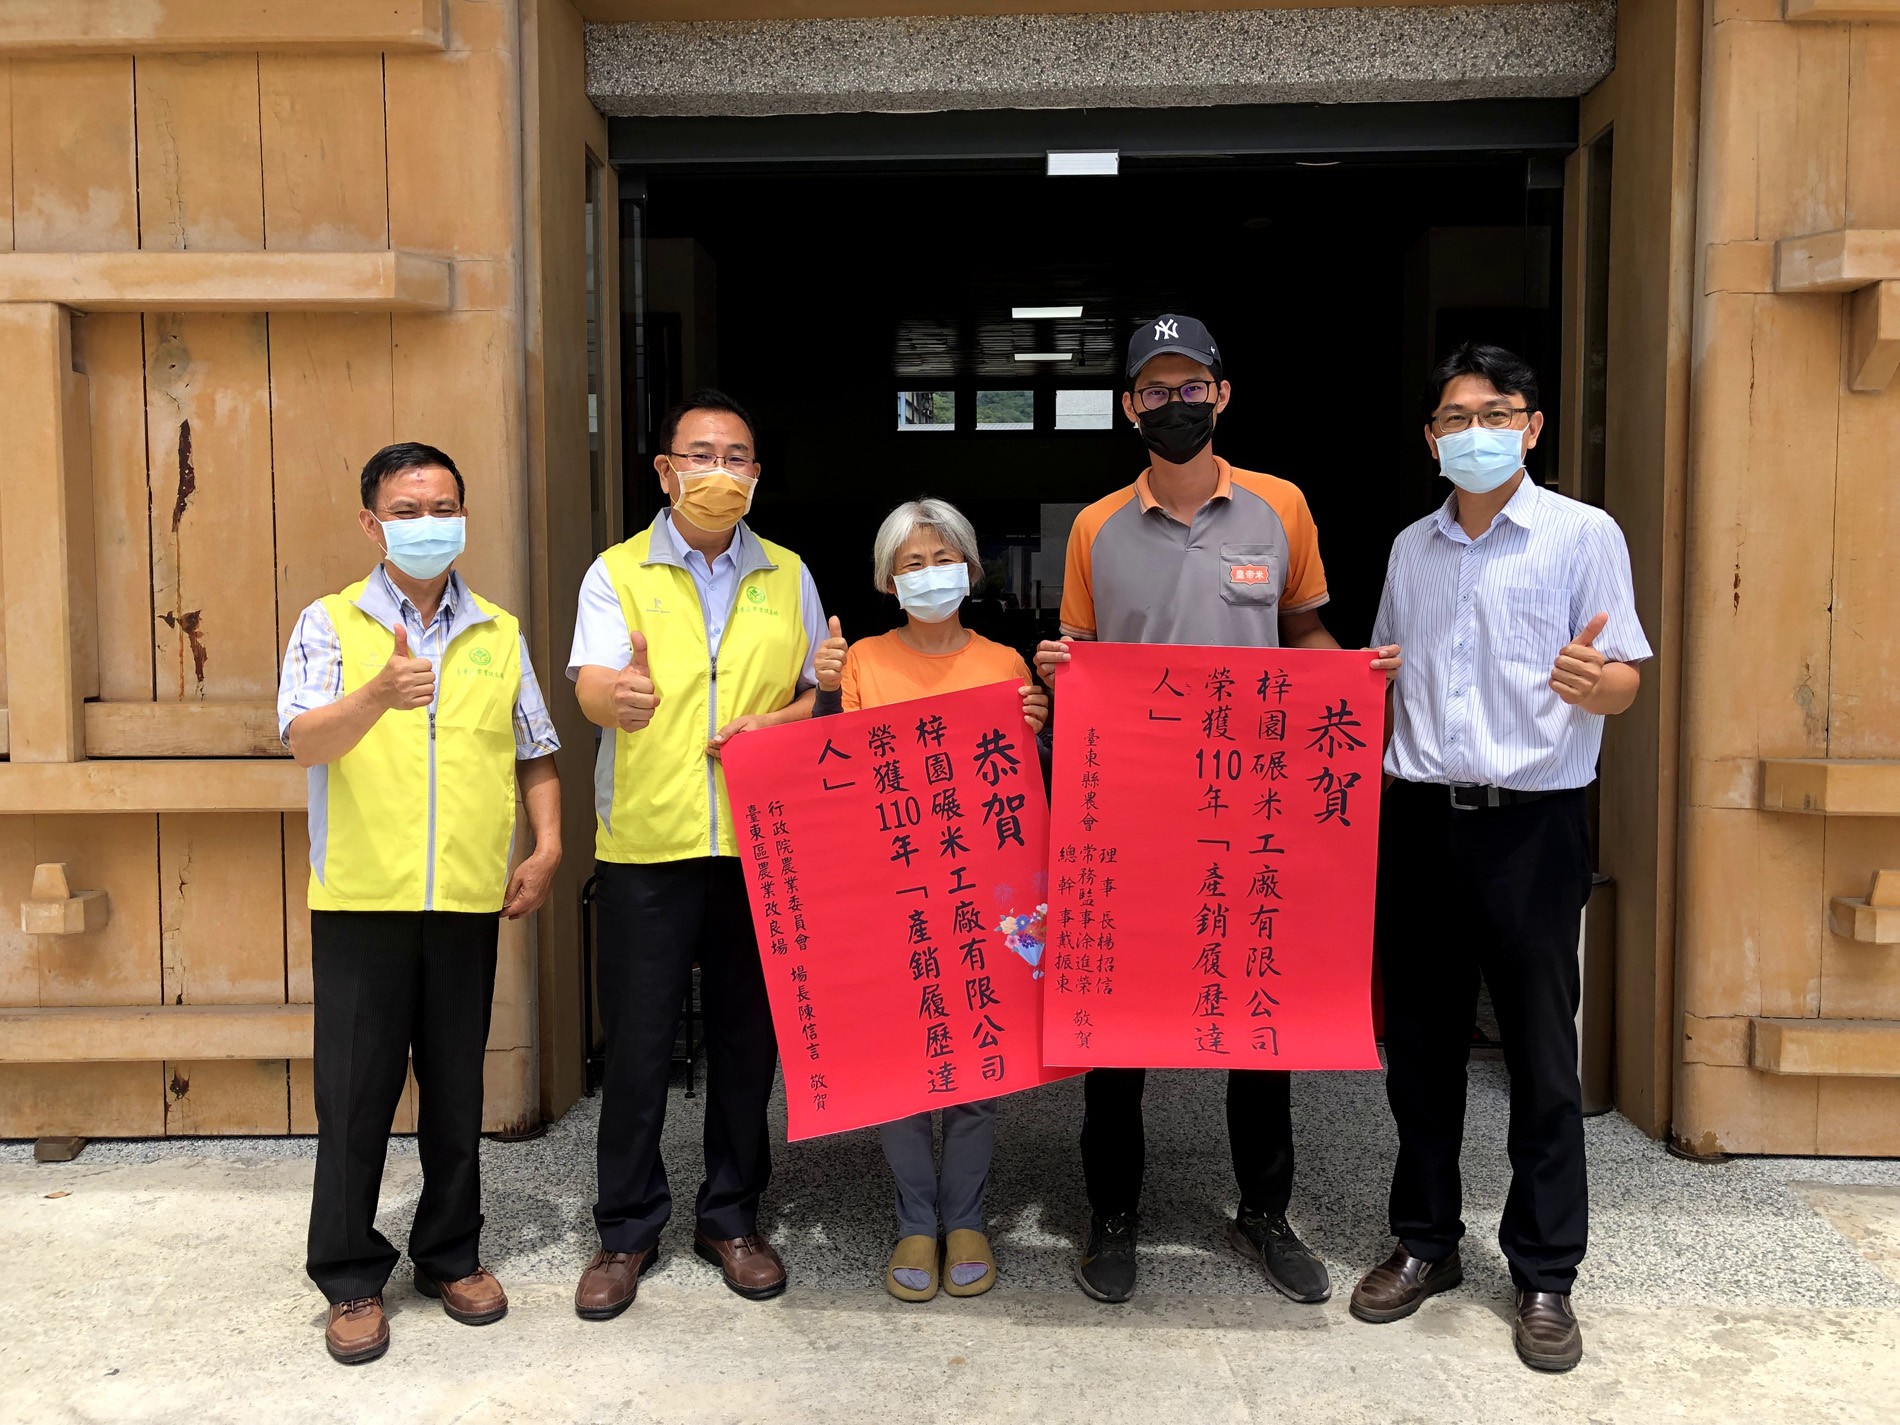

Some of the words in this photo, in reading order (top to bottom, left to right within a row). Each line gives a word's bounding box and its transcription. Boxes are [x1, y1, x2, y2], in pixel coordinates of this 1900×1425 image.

[1154, 319, 1179, 340] NY
[973, 728, 1025, 850] 恭賀
[1080, 728, 1100, 831] 臺東縣農會
[1305, 699, 1367, 827] 恭賀
[746, 805, 787, 955] 臺東區農業改良場
[768, 800, 810, 950] 行政院農業委員會
[915, 715, 1005, 1081] 梓園碾米工廠有限公司
[1246, 669, 1293, 1056] 梓園碾米工廠有限公司
[791, 965, 819, 1060] 場長陳信言
[810, 1073, 828, 1111] 敬賀
[1073, 1009, 1093, 1049] 敬賀
